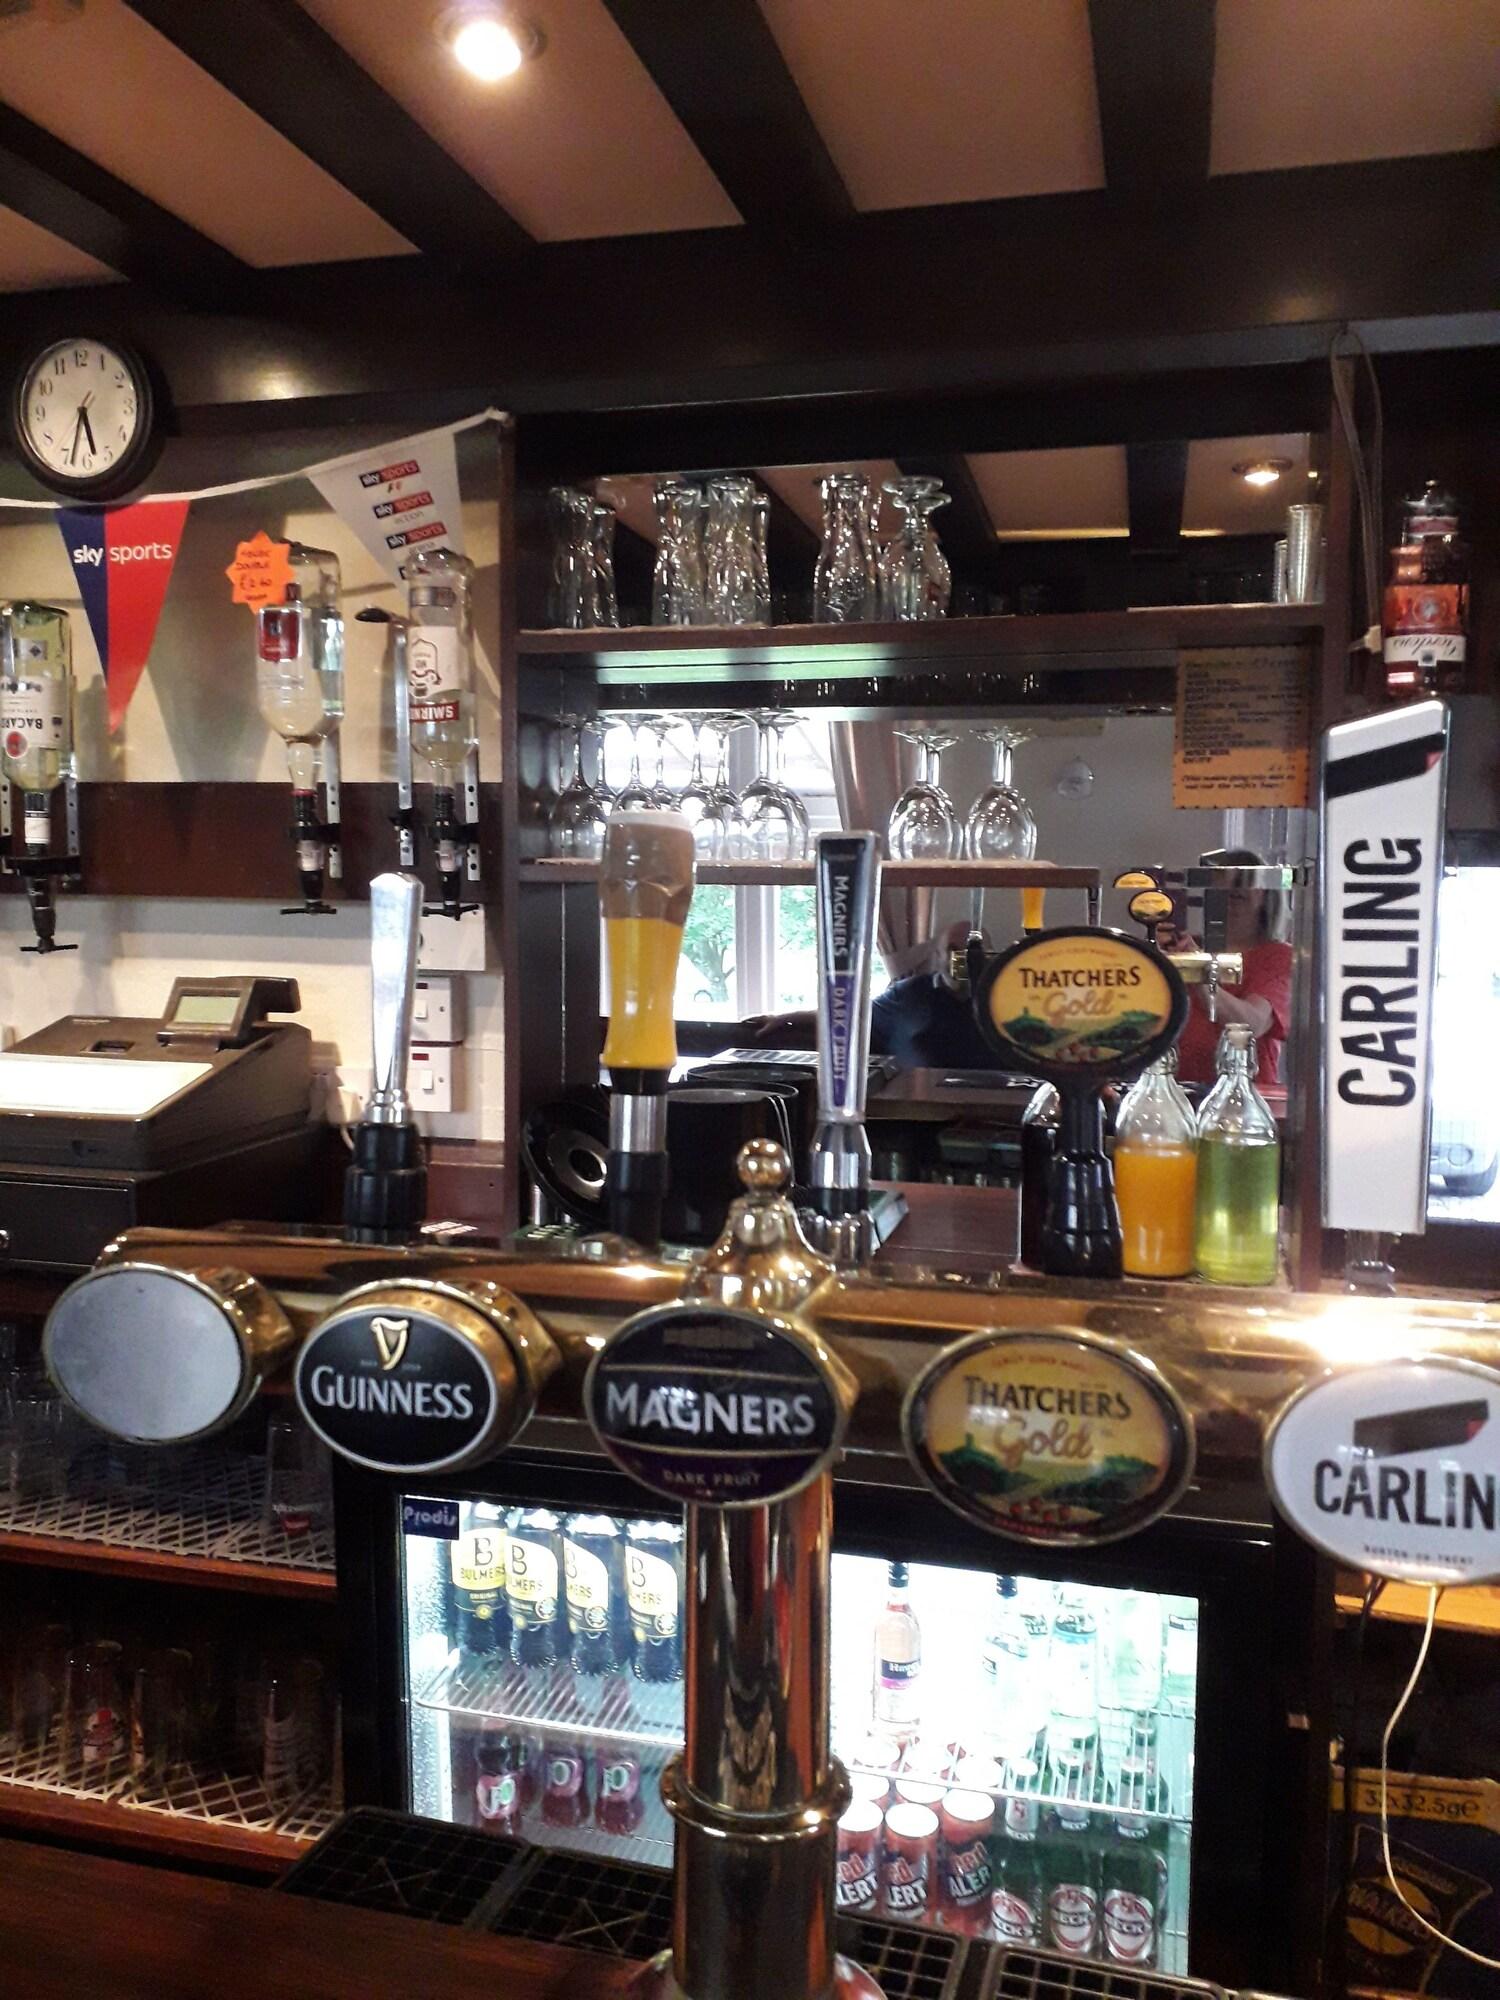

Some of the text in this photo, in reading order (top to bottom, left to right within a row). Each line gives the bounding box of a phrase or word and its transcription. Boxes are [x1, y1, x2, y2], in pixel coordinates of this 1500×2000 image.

[54, 358, 65, 375] 11
[75, 350, 88, 367] 12
[99, 353, 105, 371] 1
[38, 379, 53, 396] 10
[114, 371, 125, 388] 2
[35, 405, 46, 421] 9
[123, 398, 134, 414] 3
[61, 448, 70, 465] 7
[82, 453, 93, 471] 6
[73, 542, 173, 567] sky sports
[411, 703, 454, 720] SMIRN
[1, 716, 43, 730] BACAR
[833, 875, 850, 957] MAGNERS
[1018, 965, 1142, 989] THATCHERS
[1337, 836, 1422, 1108] CARLING
[1043, 989, 1115, 1027] Gold
[831, 986, 847, 1081] DARK FRUIT
[311, 1364, 475, 1420] GUINNESS
[964, 1375, 1133, 1421] THATCHERS
[606, 1380, 816, 1436] MAGNERS
[993, 1412, 1093, 1472] Gold
[662, 1468, 762, 1486] DARK FRUIT
[1314, 1458, 1500, 1532] CARLIN
